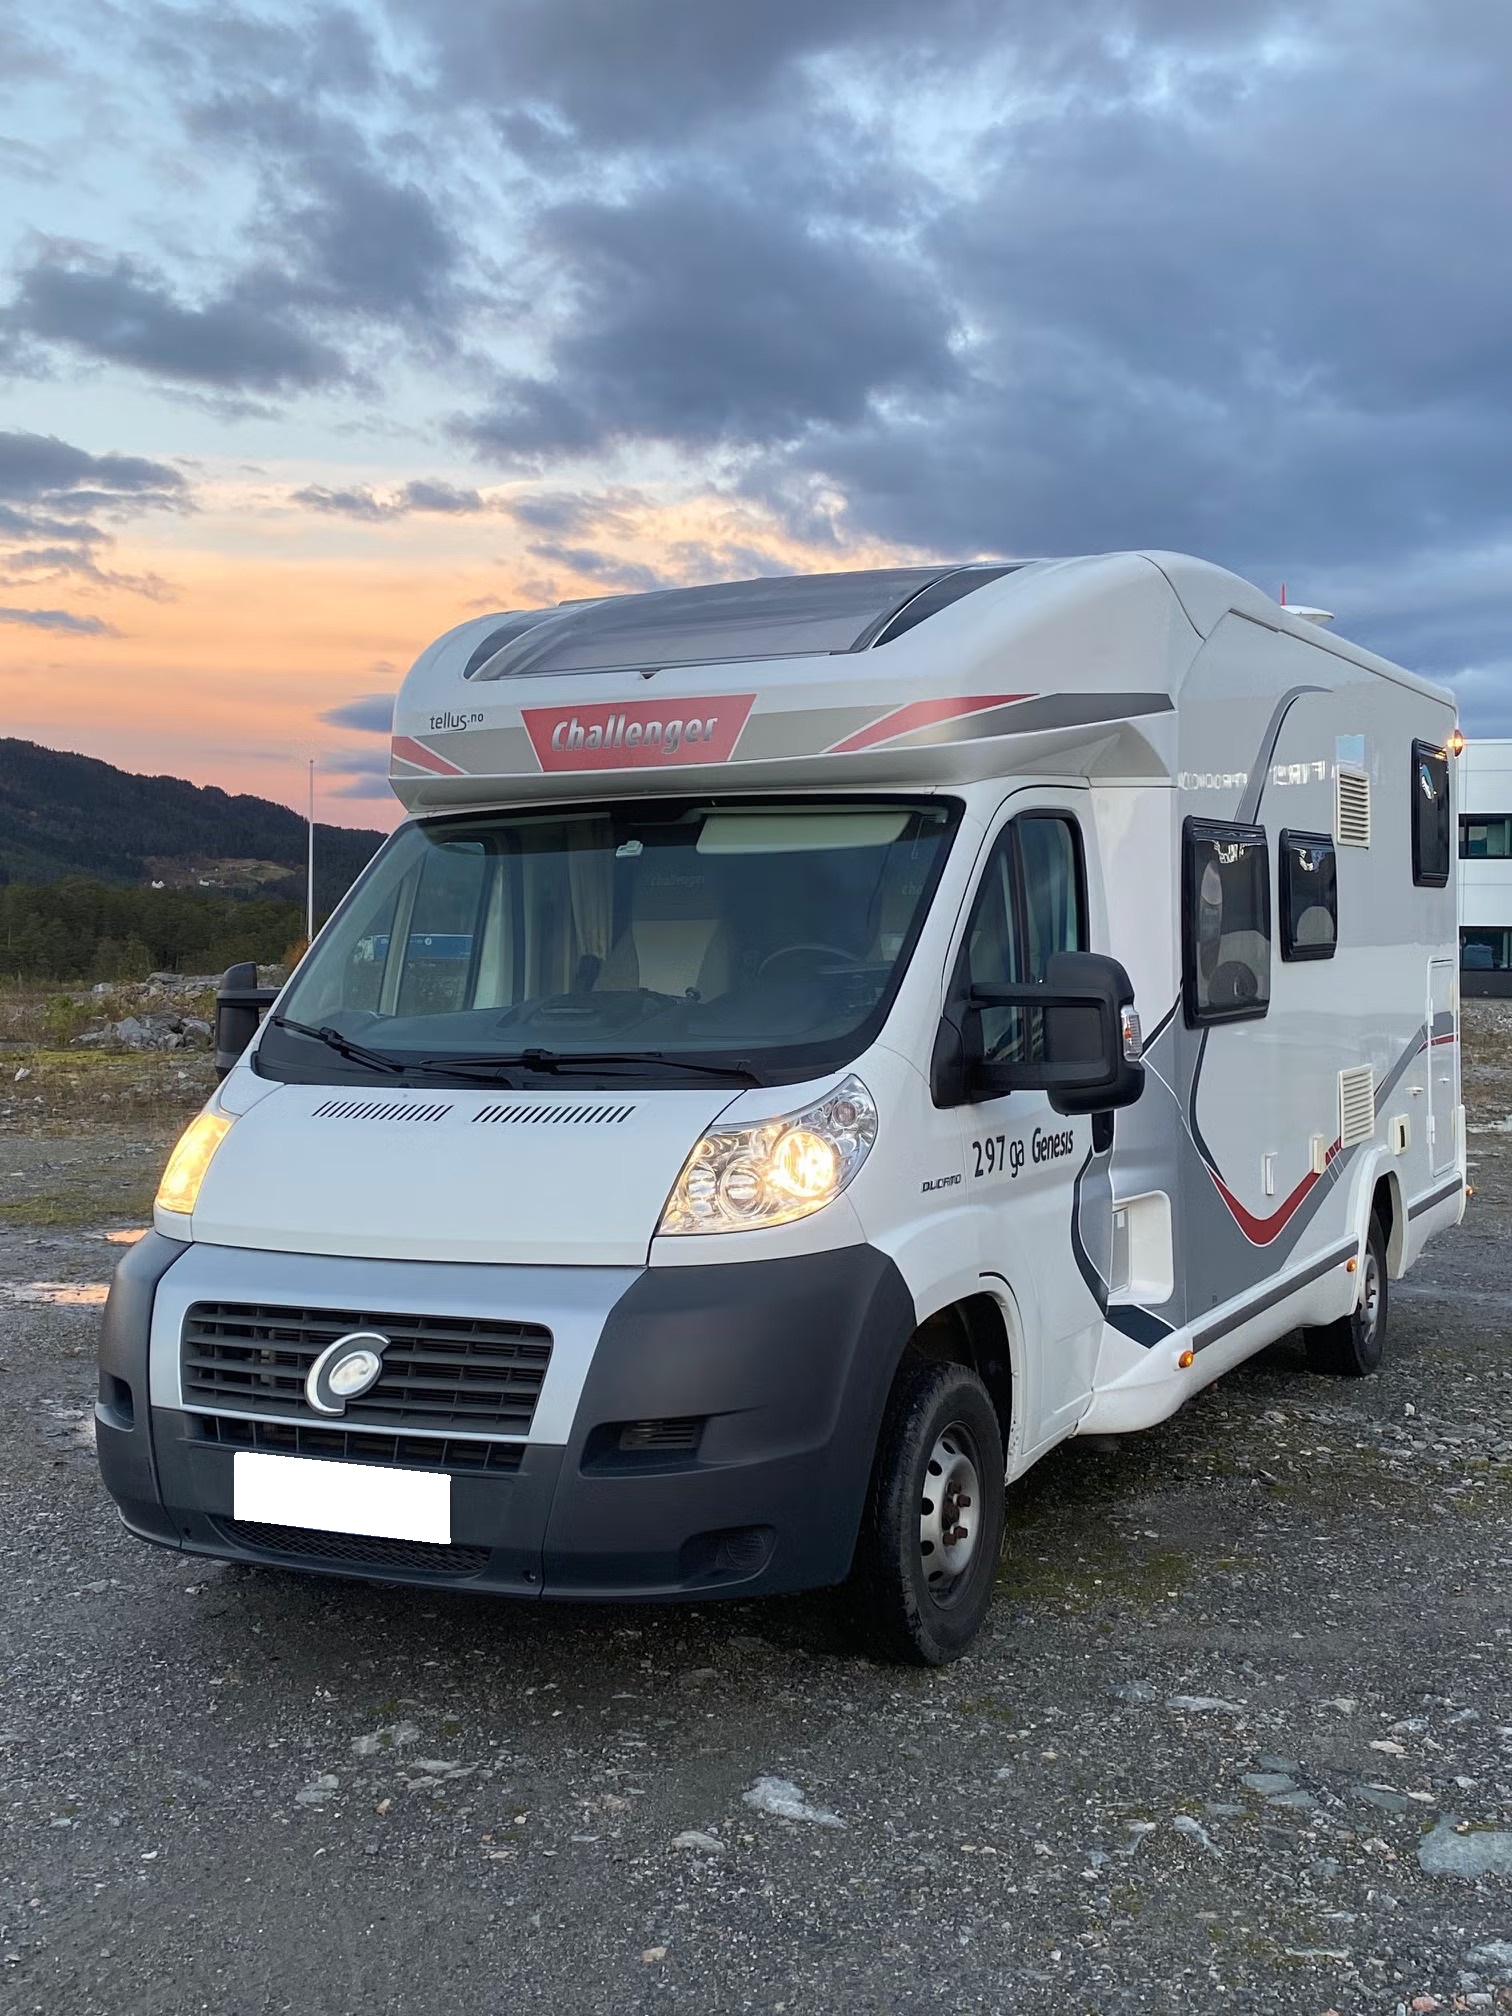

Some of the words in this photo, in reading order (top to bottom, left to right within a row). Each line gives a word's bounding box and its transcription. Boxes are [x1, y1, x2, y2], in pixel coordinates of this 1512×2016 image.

[429, 711, 484, 732] tellus.no
[551, 713, 719, 755] Challenger
[972, 1135, 1006, 1178] 297
[1009, 1140, 1025, 1178] ga
[1032, 1127, 1074, 1164] Genesis
[921, 1173, 962, 1193] DUCATO
